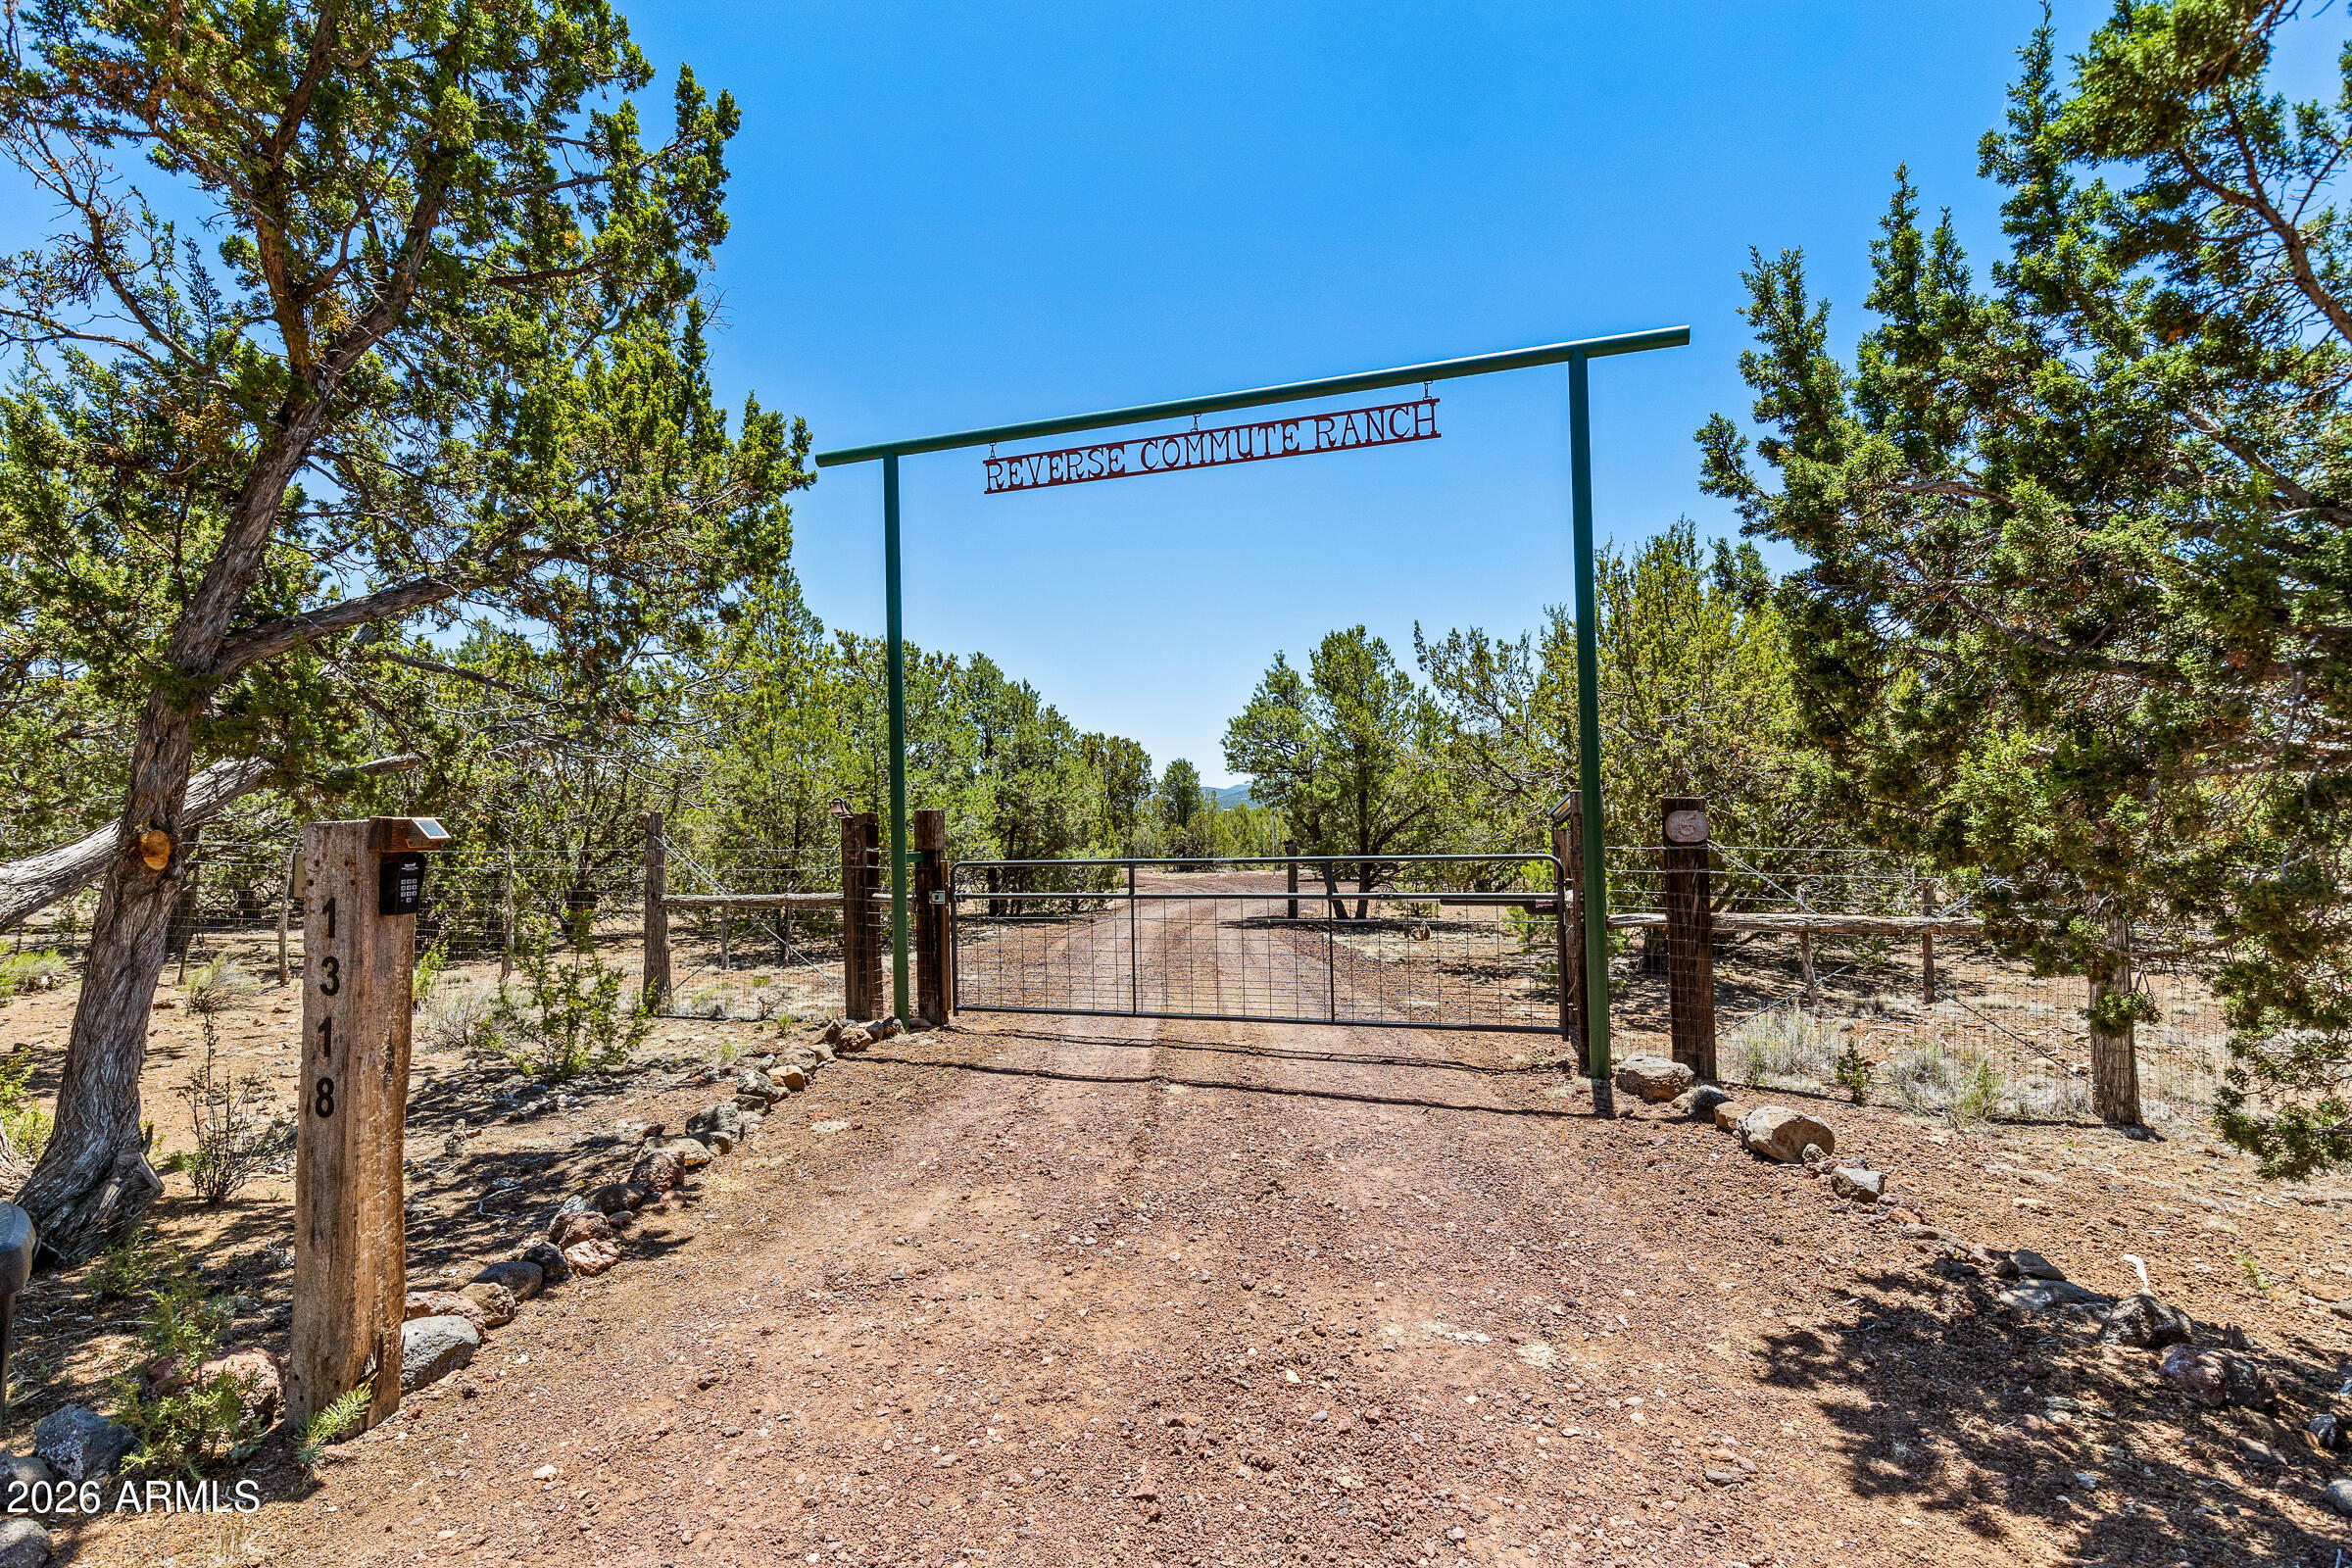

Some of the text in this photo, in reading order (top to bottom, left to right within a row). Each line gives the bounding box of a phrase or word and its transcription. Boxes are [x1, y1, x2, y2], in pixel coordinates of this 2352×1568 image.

[985, 400, 1438, 492] REVERSE COMMUTE RANCH
[315, 897, 340, 1118] 1318
